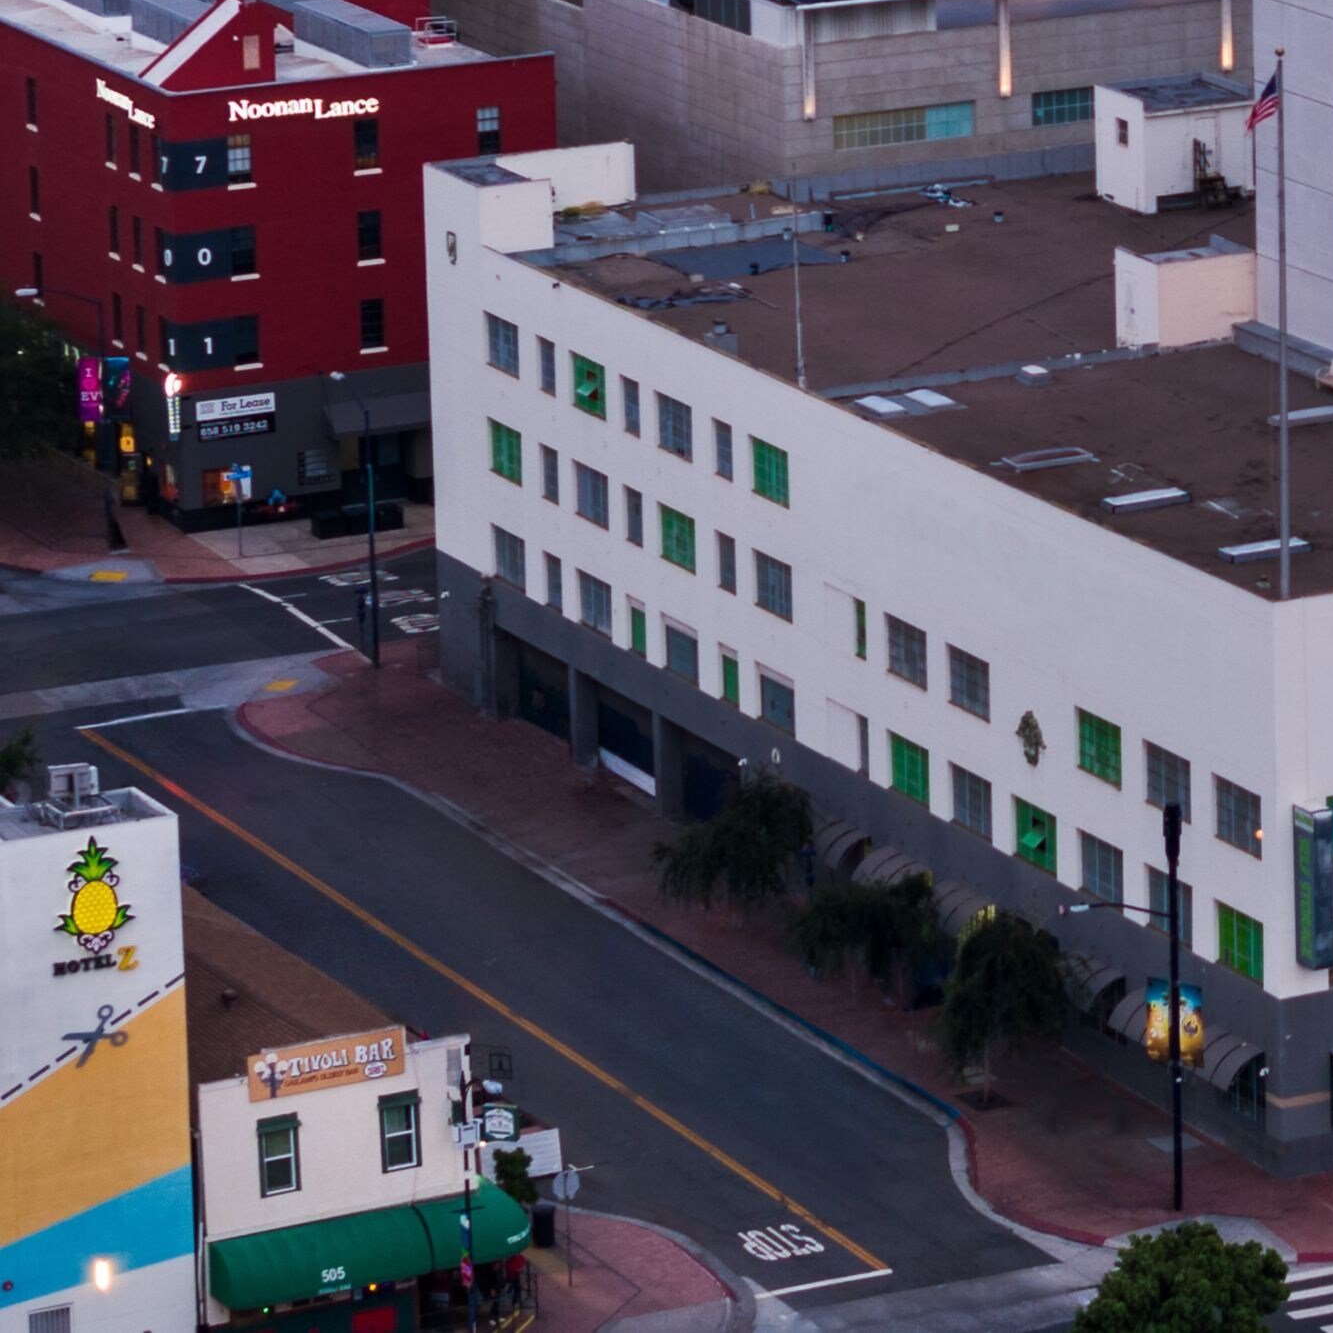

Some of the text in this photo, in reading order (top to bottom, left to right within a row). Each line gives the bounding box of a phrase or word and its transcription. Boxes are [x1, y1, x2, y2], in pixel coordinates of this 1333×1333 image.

[228, 97, 379, 121] Noonan Lance
[195, 156, 207, 174] 7
[203, 337, 213, 355] 1
[221, 401, 237, 411] For
[239, 397, 270, 409] Lease
[53, 945, 139, 976] HOTEL Z
[288, 1037, 396, 1077] TIVOLI BAR
[737, 1223, 825, 1261] STOP
[321, 1266, 346, 1283] 505
